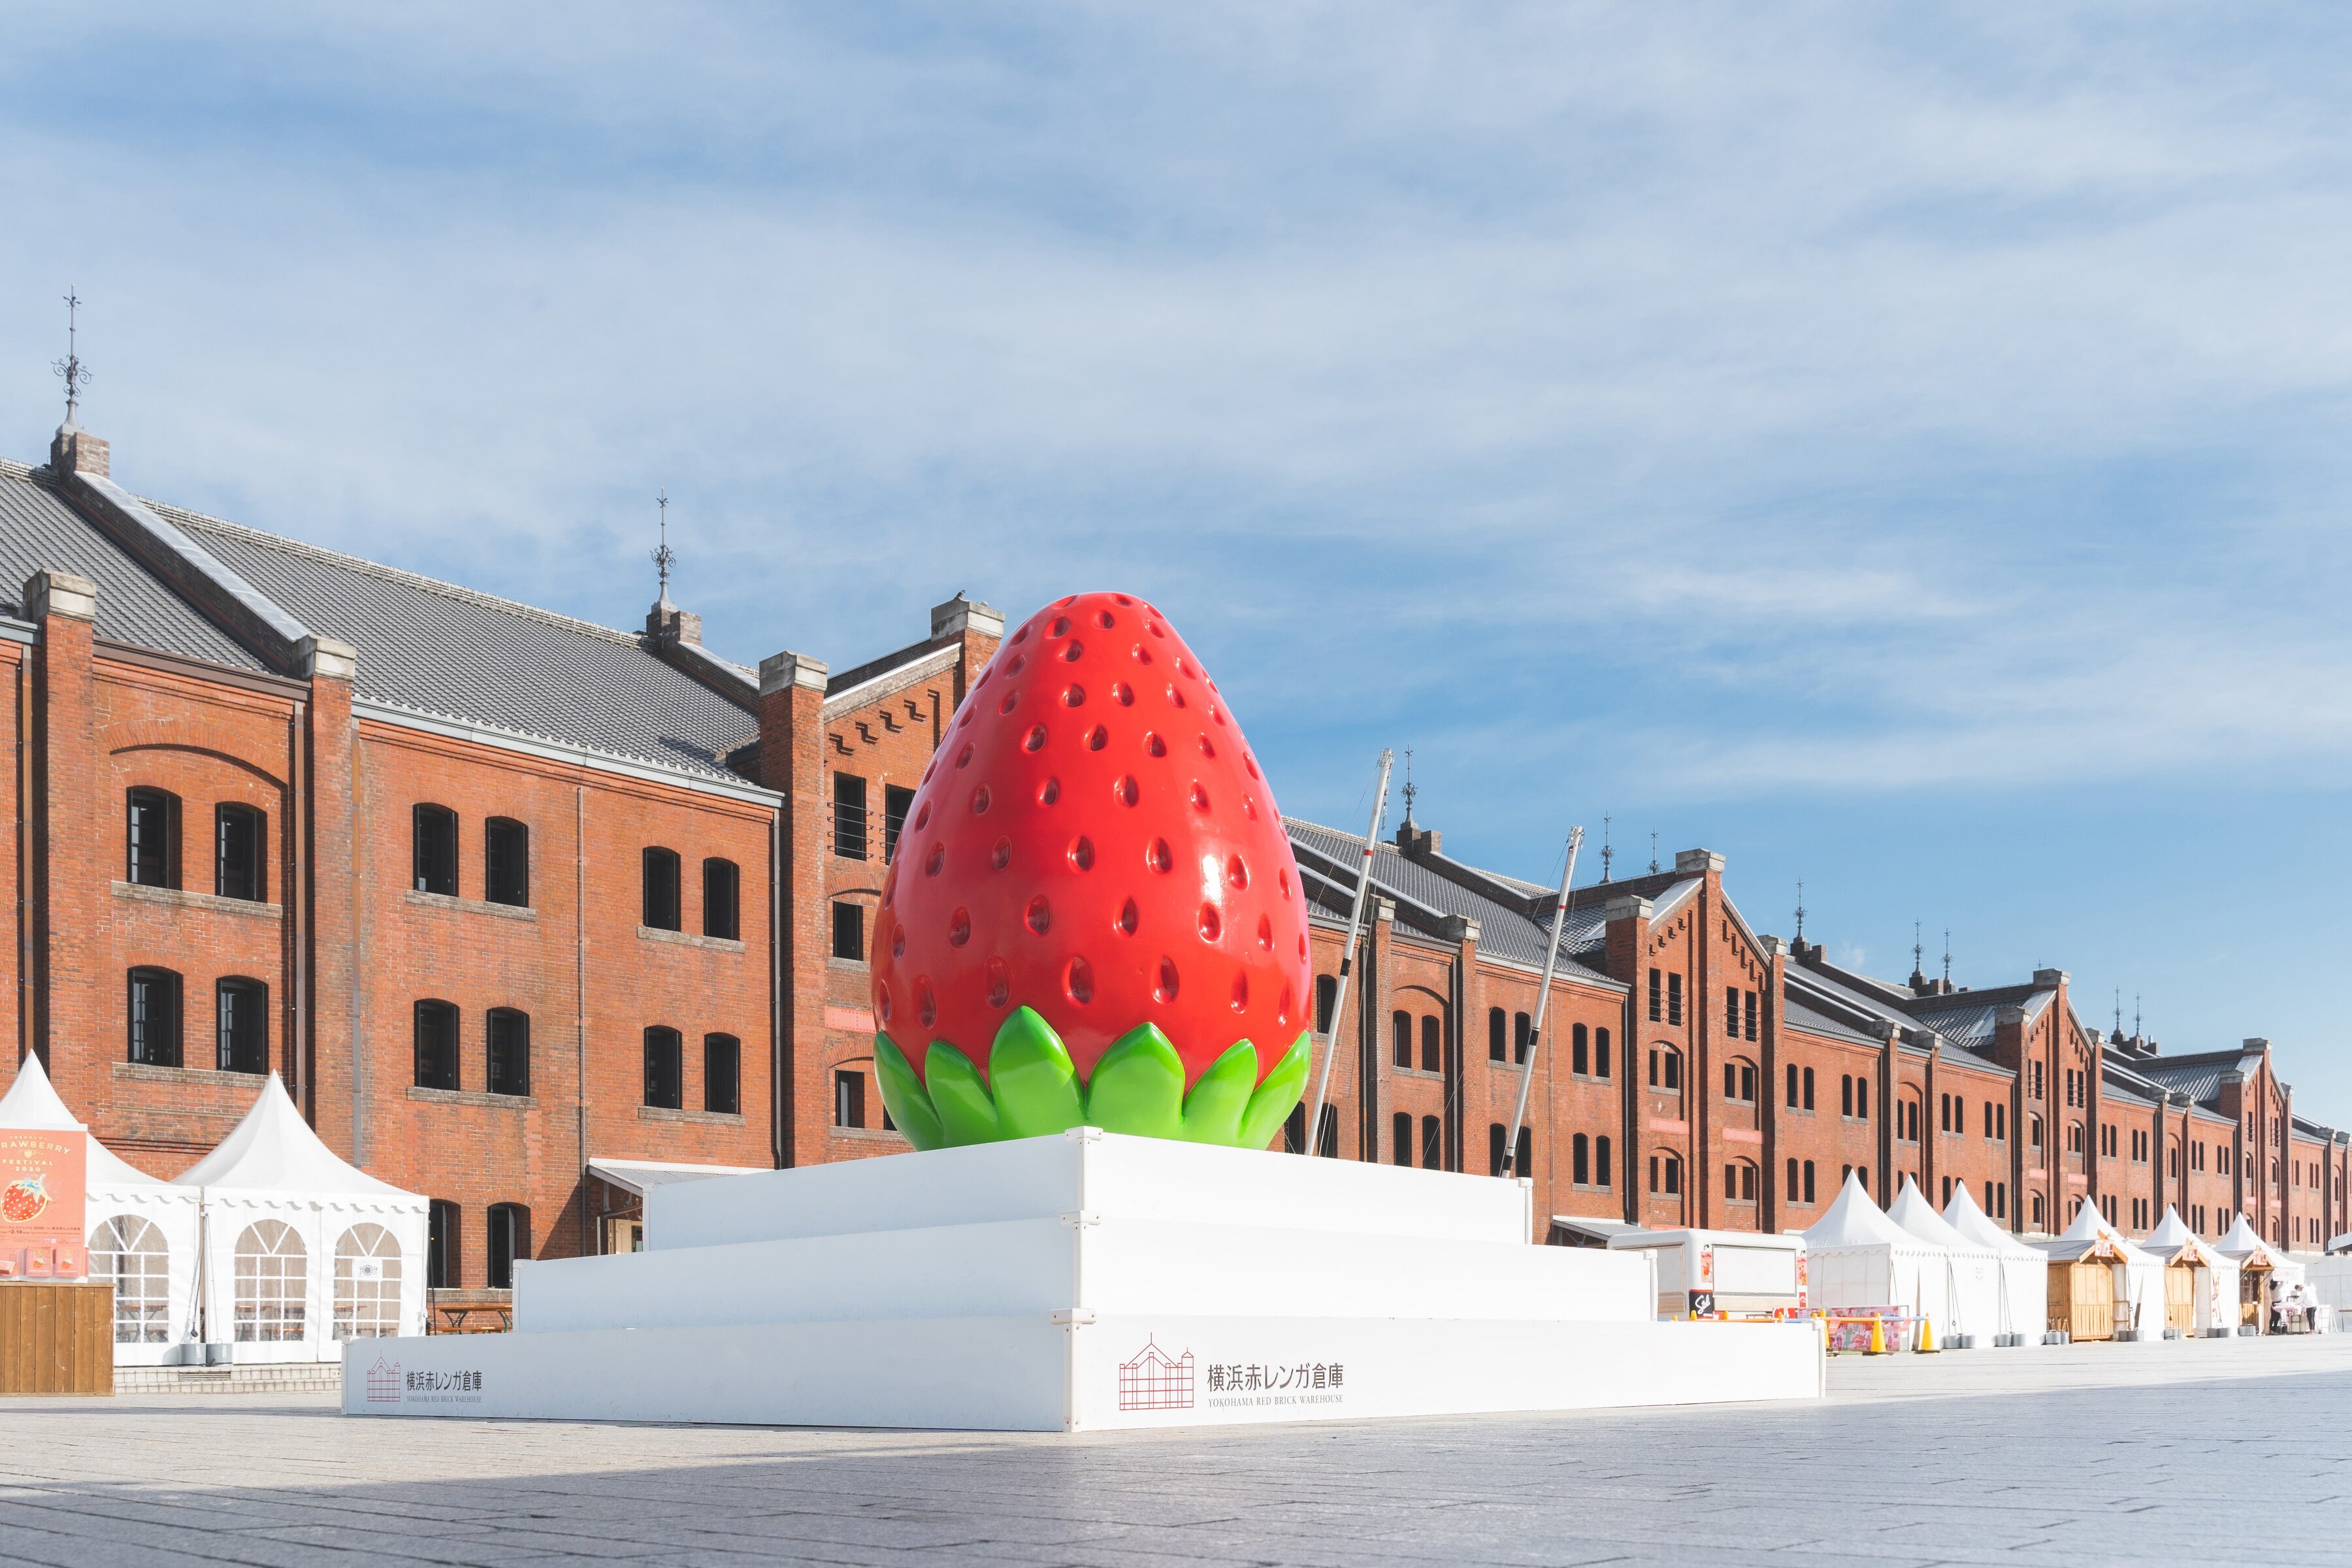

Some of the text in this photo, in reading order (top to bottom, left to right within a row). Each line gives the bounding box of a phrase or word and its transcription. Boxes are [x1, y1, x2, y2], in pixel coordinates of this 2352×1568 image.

[406, 1370, 482, 1392] 横浜赤レンガ倉庫
[1207, 1362, 1344, 1392] 横浜赤レンガ倉庫
[1208, 1394, 1343, 1408] YOKOHAMA RED BRICK WAREHOUSE
